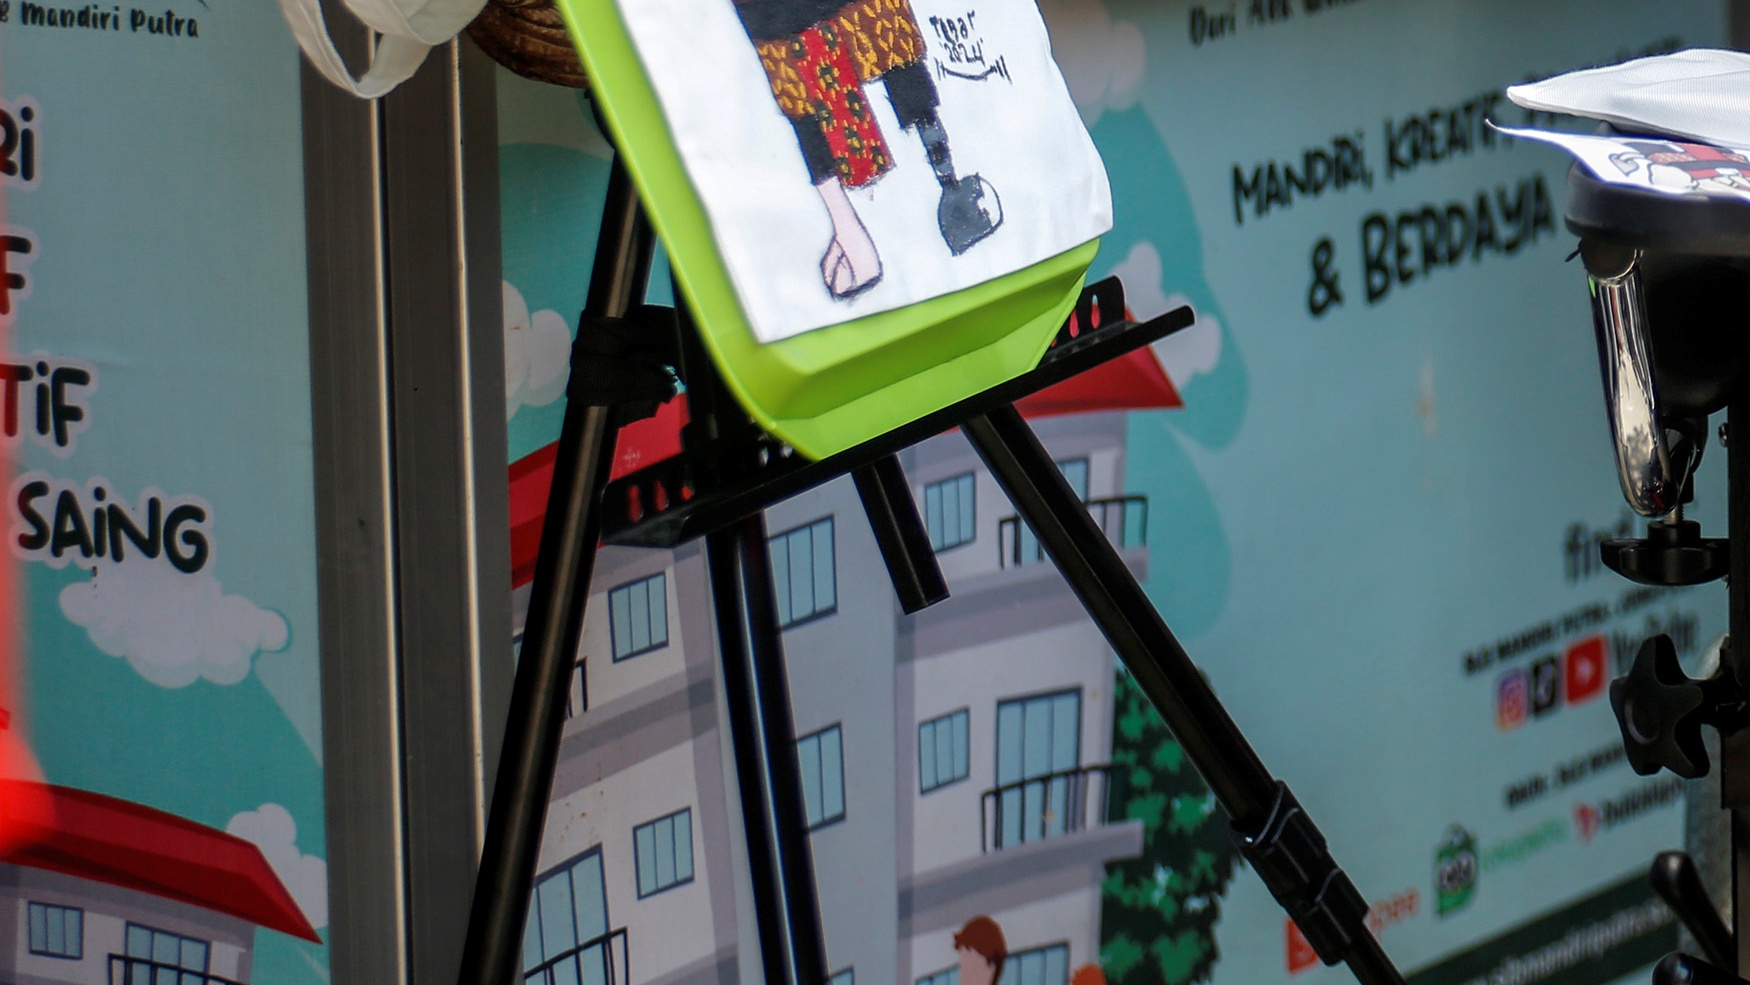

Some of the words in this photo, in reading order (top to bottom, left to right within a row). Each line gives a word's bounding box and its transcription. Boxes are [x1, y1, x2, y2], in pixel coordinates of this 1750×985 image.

[20, 0, 120, 31] Mandiri
[130, 7, 199, 38] Putra
[1307, 234, 1344, 319] &
[1361, 169, 1554, 306] BERDAYA
